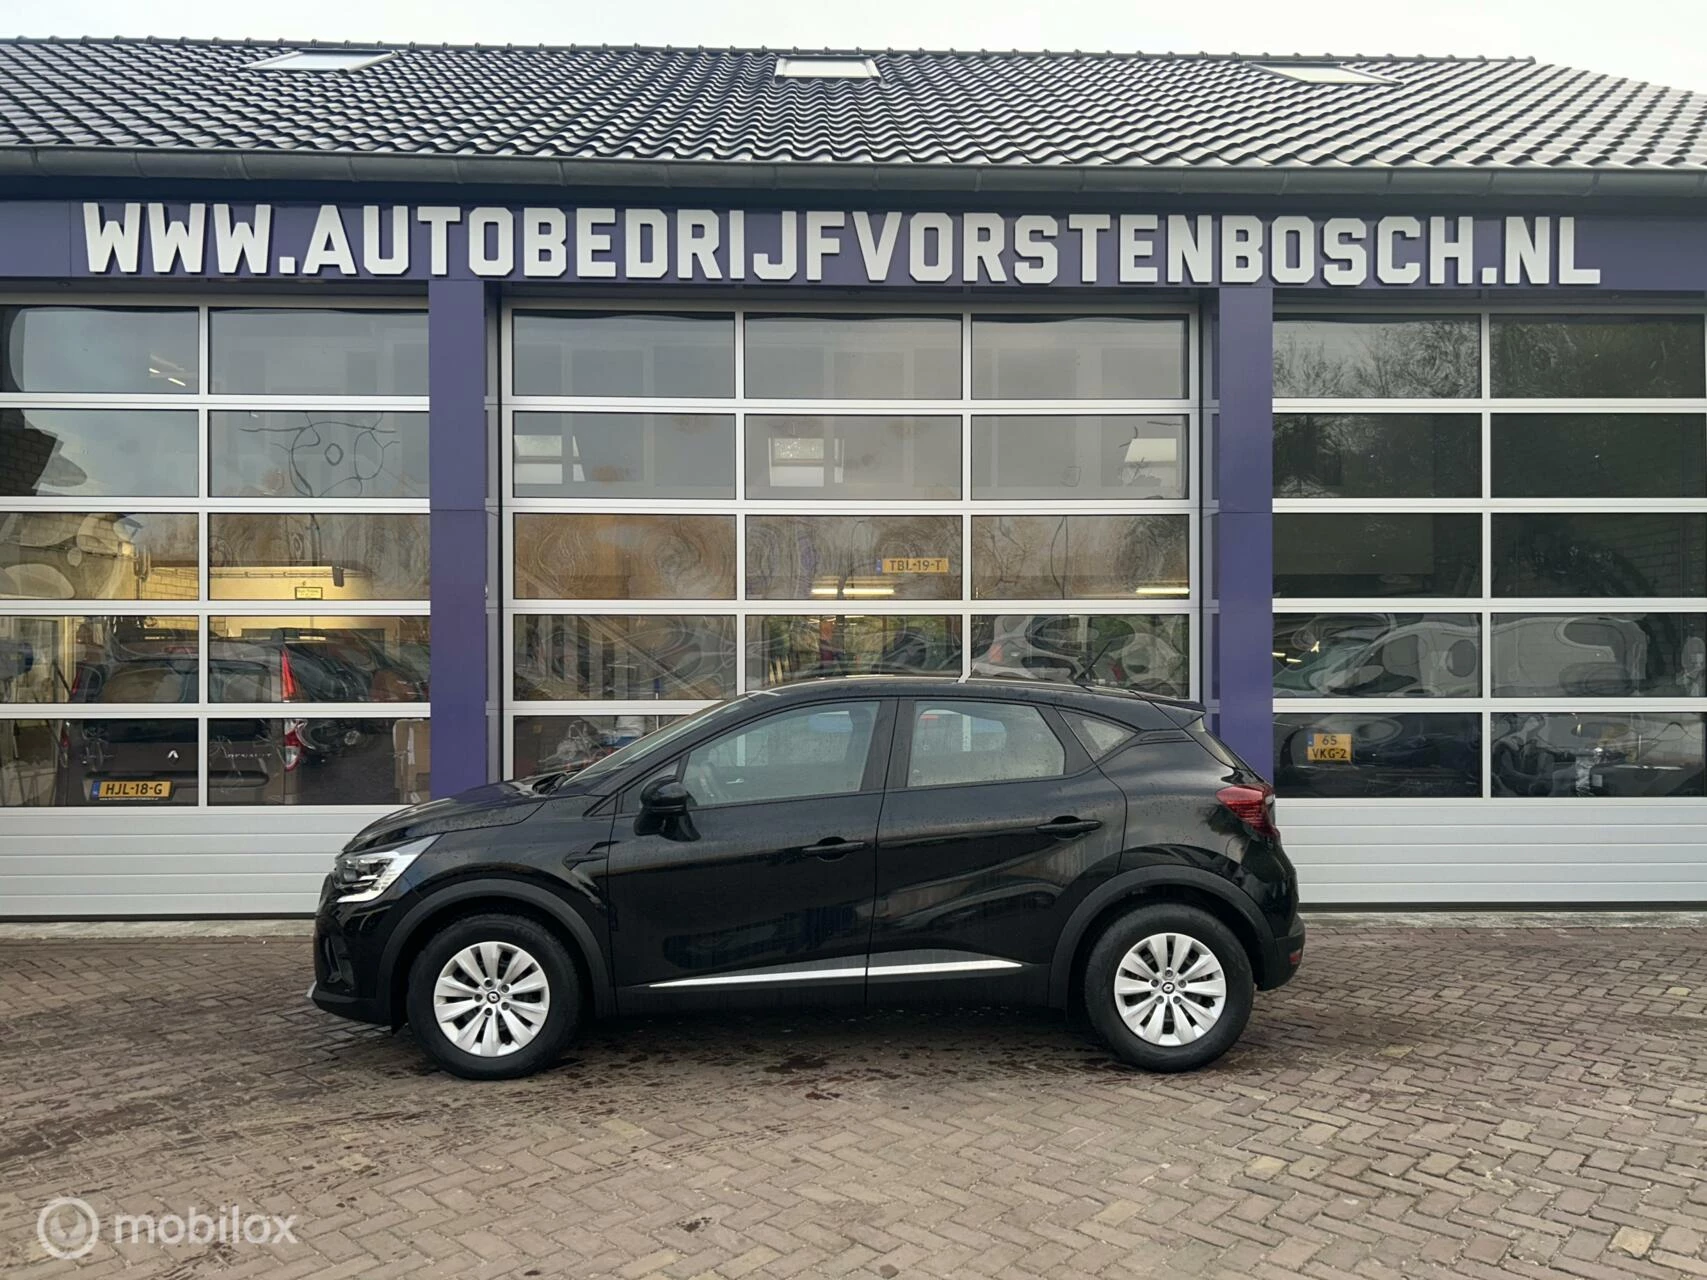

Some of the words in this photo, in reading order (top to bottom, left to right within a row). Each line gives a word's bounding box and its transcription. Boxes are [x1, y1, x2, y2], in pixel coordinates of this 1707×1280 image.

[83, 202, 1601, 286] WWW.AUTOBEDRIJFVORSTENBOSCH.NL
[889, 559, 942, 572] TBL-19-T
[1322, 735, 1338, 746] 65
[1311, 747, 1348, 759] VKG-2
[105, 782, 163, 795] HJL-18-G
